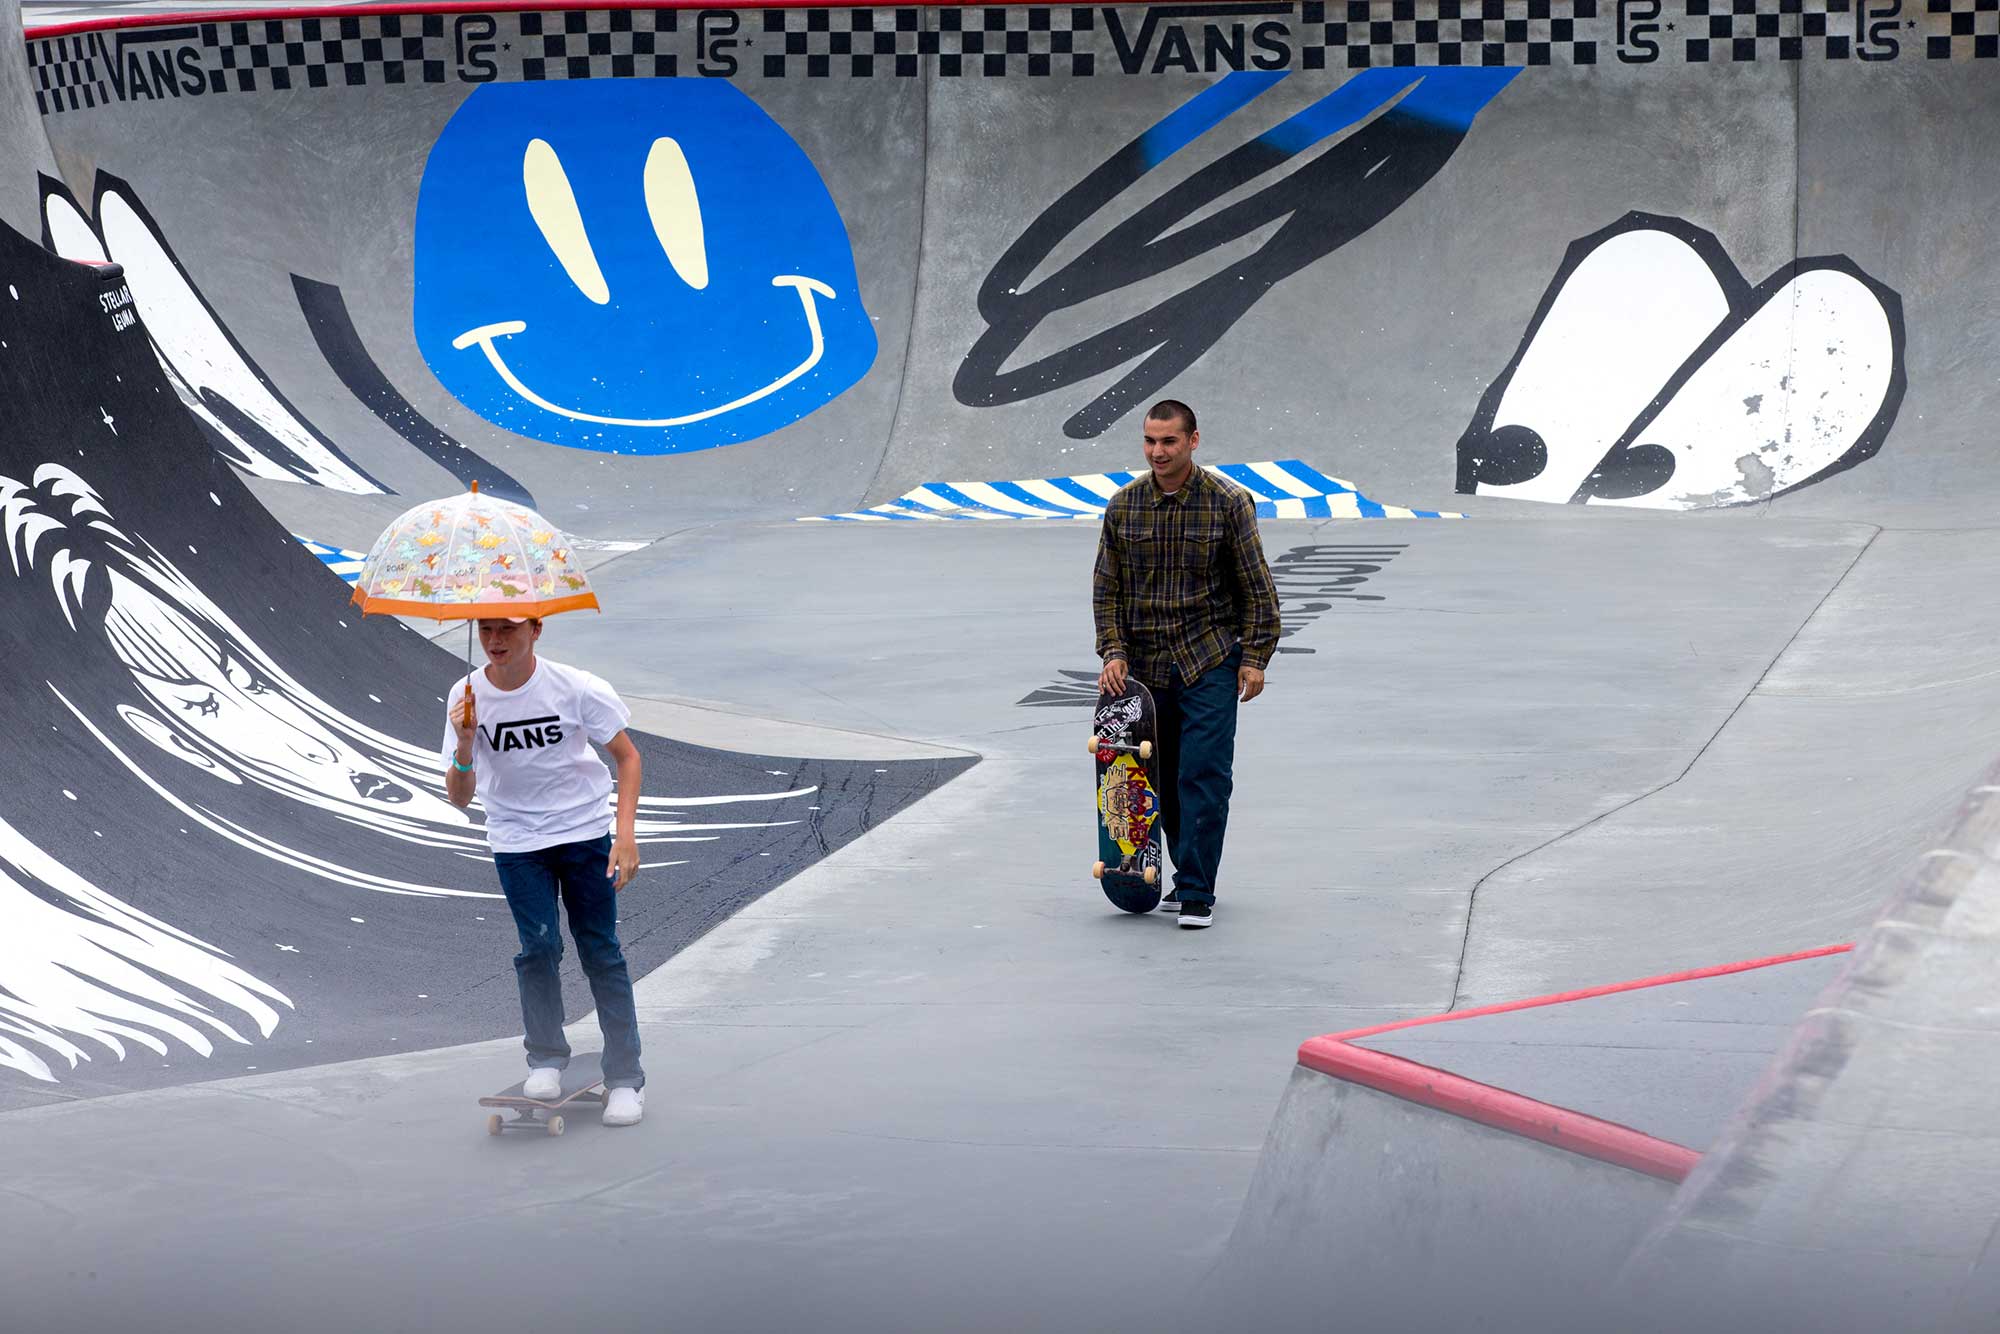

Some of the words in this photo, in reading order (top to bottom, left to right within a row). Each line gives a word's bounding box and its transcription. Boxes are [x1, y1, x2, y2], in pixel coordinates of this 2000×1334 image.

[97, 26, 207, 102] VANS
[1102, 3, 1293, 74] VANS
[98, 285, 133, 314] STELLAR
[478, 715, 564, 752] VANS
